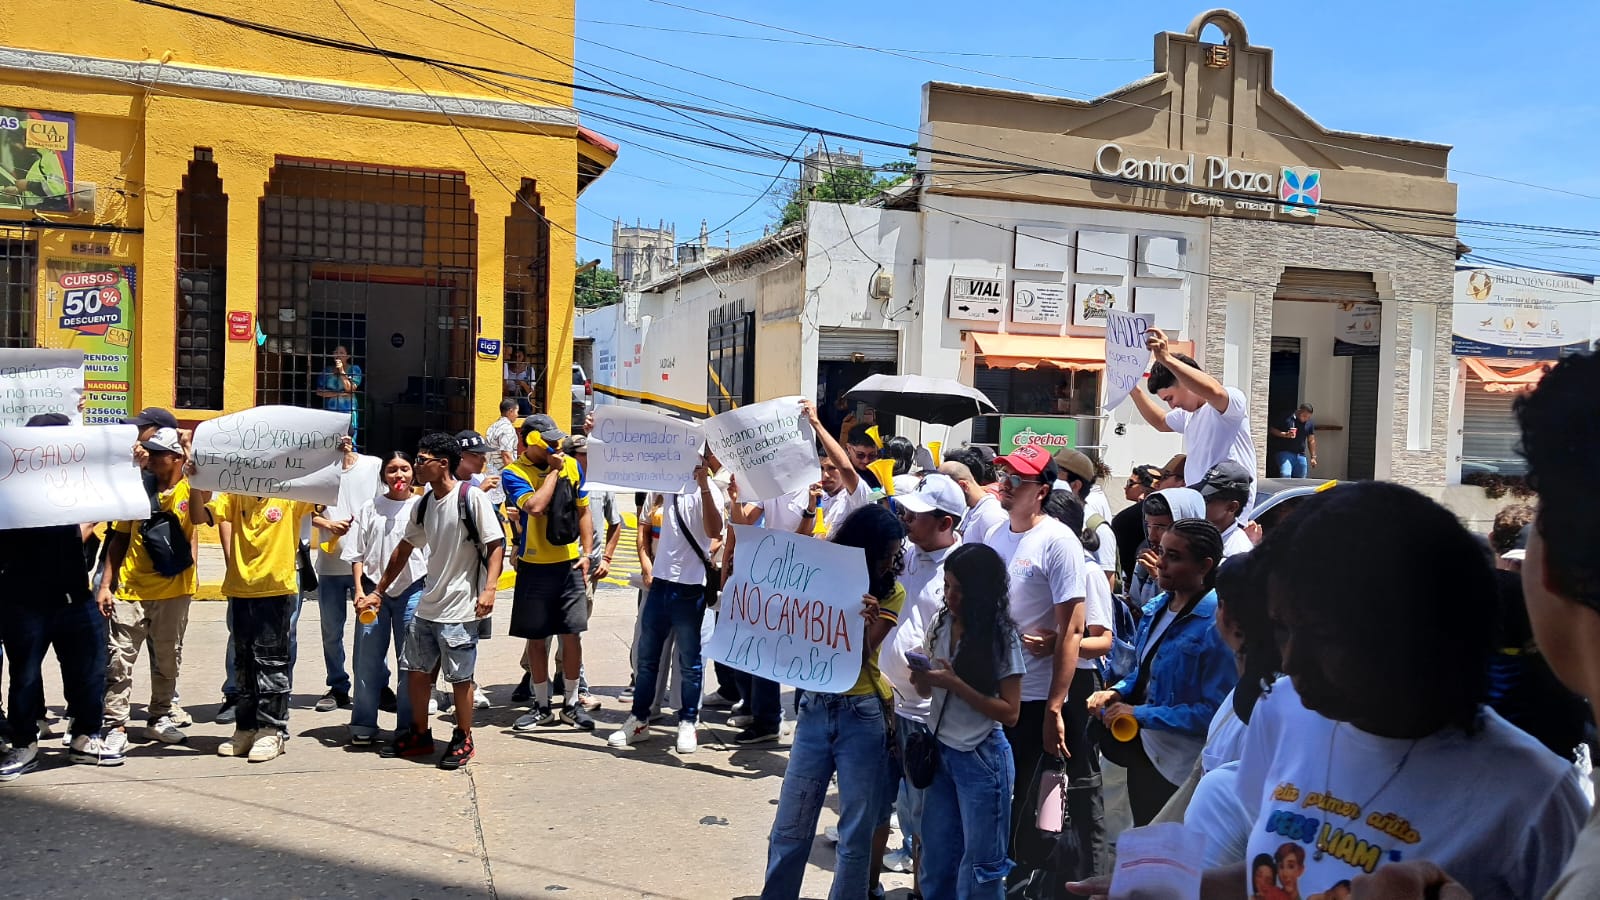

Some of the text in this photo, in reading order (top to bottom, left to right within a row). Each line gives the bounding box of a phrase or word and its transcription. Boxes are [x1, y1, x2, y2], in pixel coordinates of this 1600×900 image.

[31, 123, 57, 134] CIA
[47, 134, 65, 142] VIP
[1096, 143, 1273, 193] Central Plaza
[1191, 192, 1225, 207] Centro
[64, 273, 113, 286] CURSOS
[64, 314, 118, 326] DESCUENTO
[480, 341, 497, 353] tigo
[84, 354, 119, 362] RENDOS
[56, 368, 74, 379] se
[7, 388, 25, 399] no
[89, 393, 127, 401] Tu Curso
[86, 408, 128, 416] 3256061
[85, 416, 122, 424] 338840
[685, 426, 696, 447] la
[719, 427, 755, 448] decano
[758, 422, 775, 435] no
[193, 448, 221, 467] NI
[285, 456, 306, 470] NI
[637, 447, 681, 463] respeta
[750, 534, 821, 593] Callar
[730, 582, 852, 653] NO CAMBIA
[1302, 791, 1361, 820] primer
[1366, 811, 1421, 844] añito
[1316, 821, 1382, 874] LIAM
